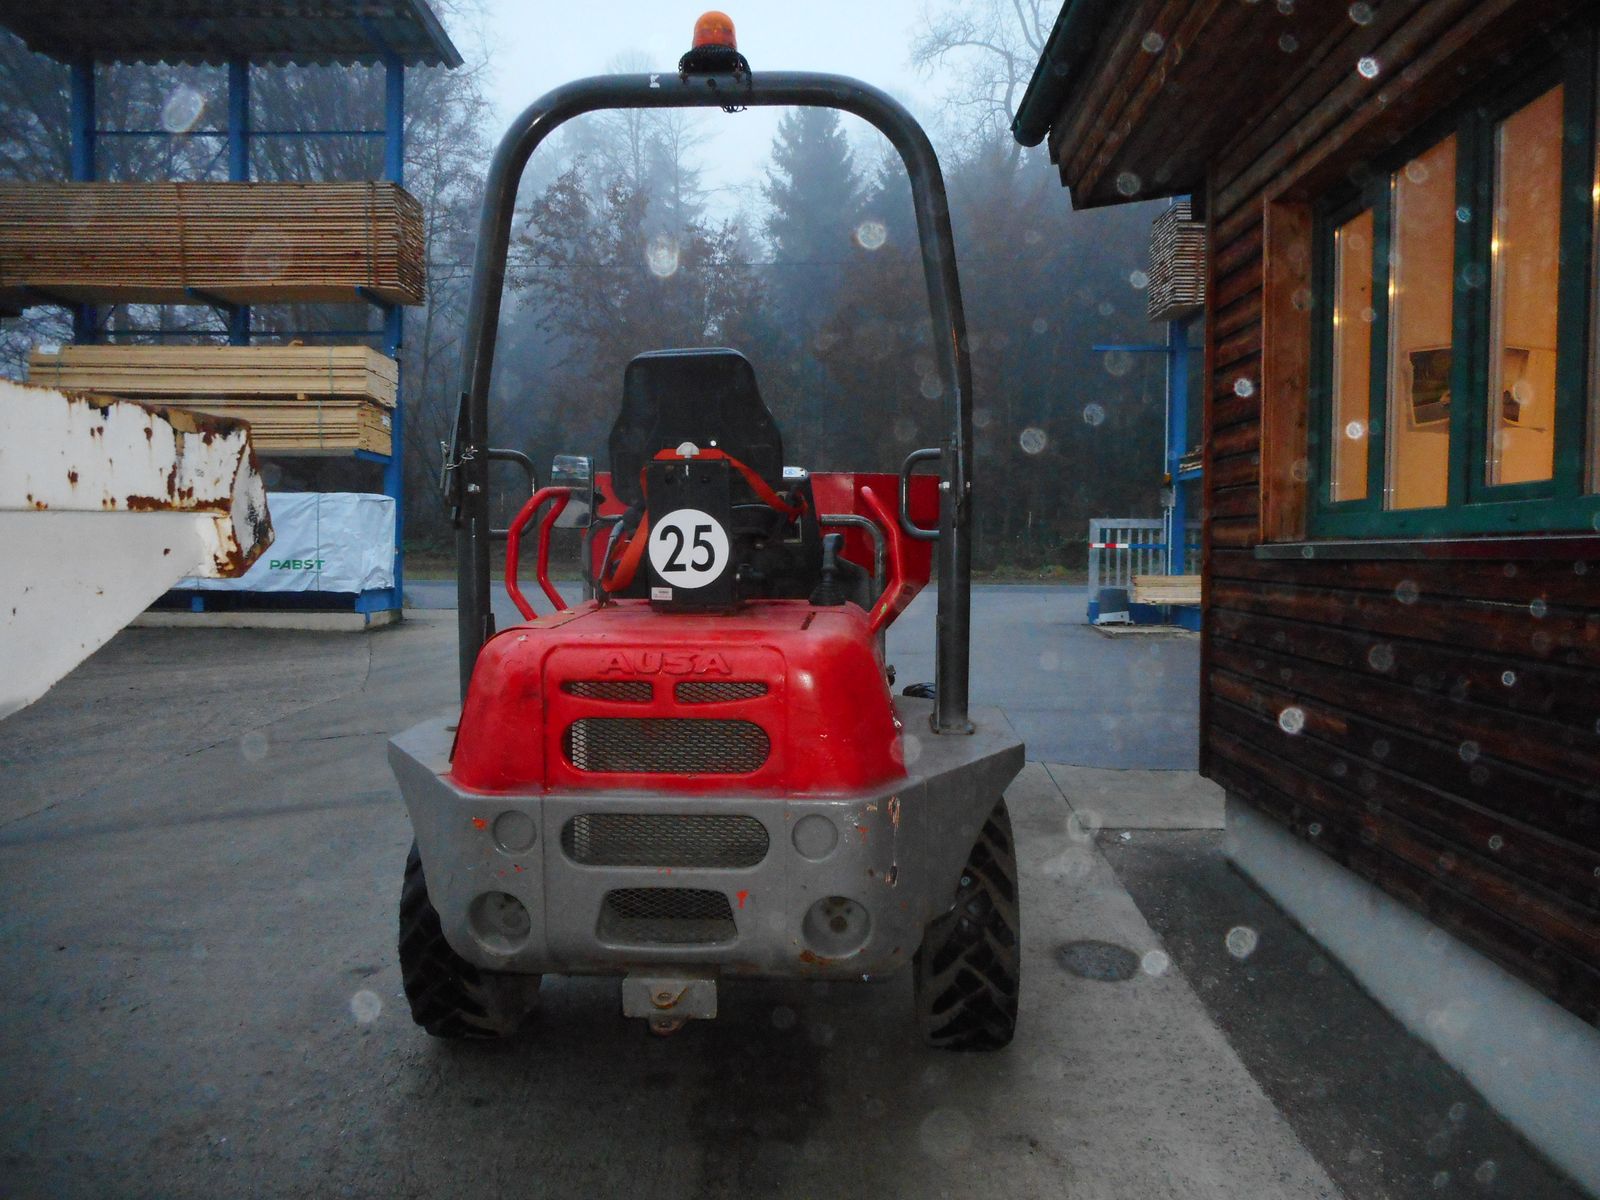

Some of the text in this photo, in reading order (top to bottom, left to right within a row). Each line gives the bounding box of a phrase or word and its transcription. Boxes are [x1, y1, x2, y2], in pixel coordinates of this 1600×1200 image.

[659, 524, 716, 573] 25
[269, 559, 325, 570] PABST
[598, 651, 733, 676] AUSA
